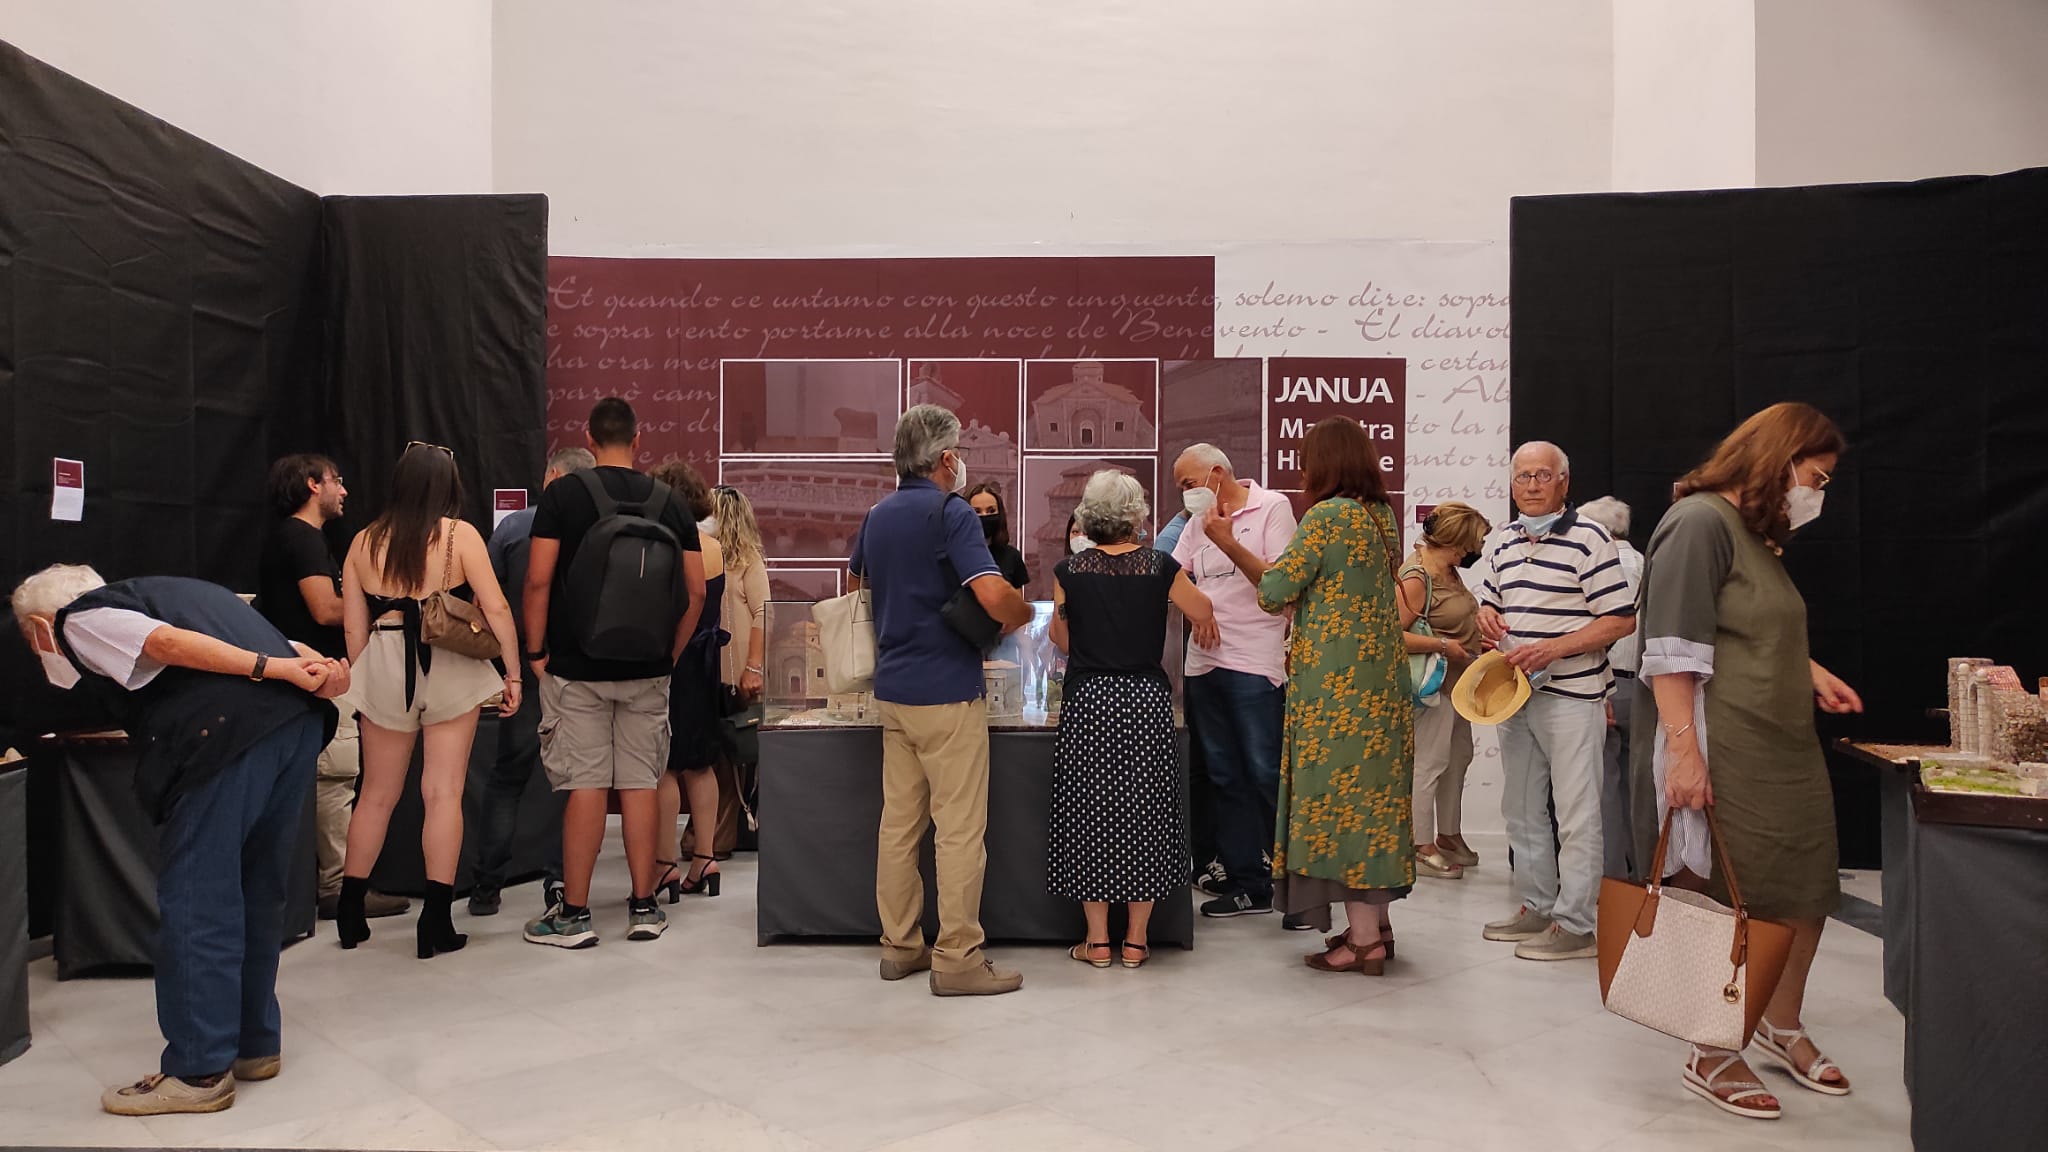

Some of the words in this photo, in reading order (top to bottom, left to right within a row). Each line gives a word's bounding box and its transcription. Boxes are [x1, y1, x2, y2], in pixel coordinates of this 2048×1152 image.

[547, 275, 594, 310] Et
[603, 282, 722, 319] quando
[731, 294, 763, 308] ce
[772, 287, 895, 309] untamo
[903, 294, 959, 308] con
[966, 286, 1059, 319] questo
[1235, 280, 1340, 307] solemo
[1348, 280, 1426, 307] dire:
[573, 322, 655, 349] sopra
[666, 319, 752, 340] vento
[760, 318, 894, 358] portame
[903, 312, 973, 339] alla
[983, 323, 1057, 339] noce
[1066, 313, 1108, 339] de
[1119, 306, 1307, 343] Benevento
[1354, 307, 1401, 342] El
[598, 354, 654, 370] ora
[1274, 376, 1394, 404] JANUA
[1450, 408, 1486, 435] la
